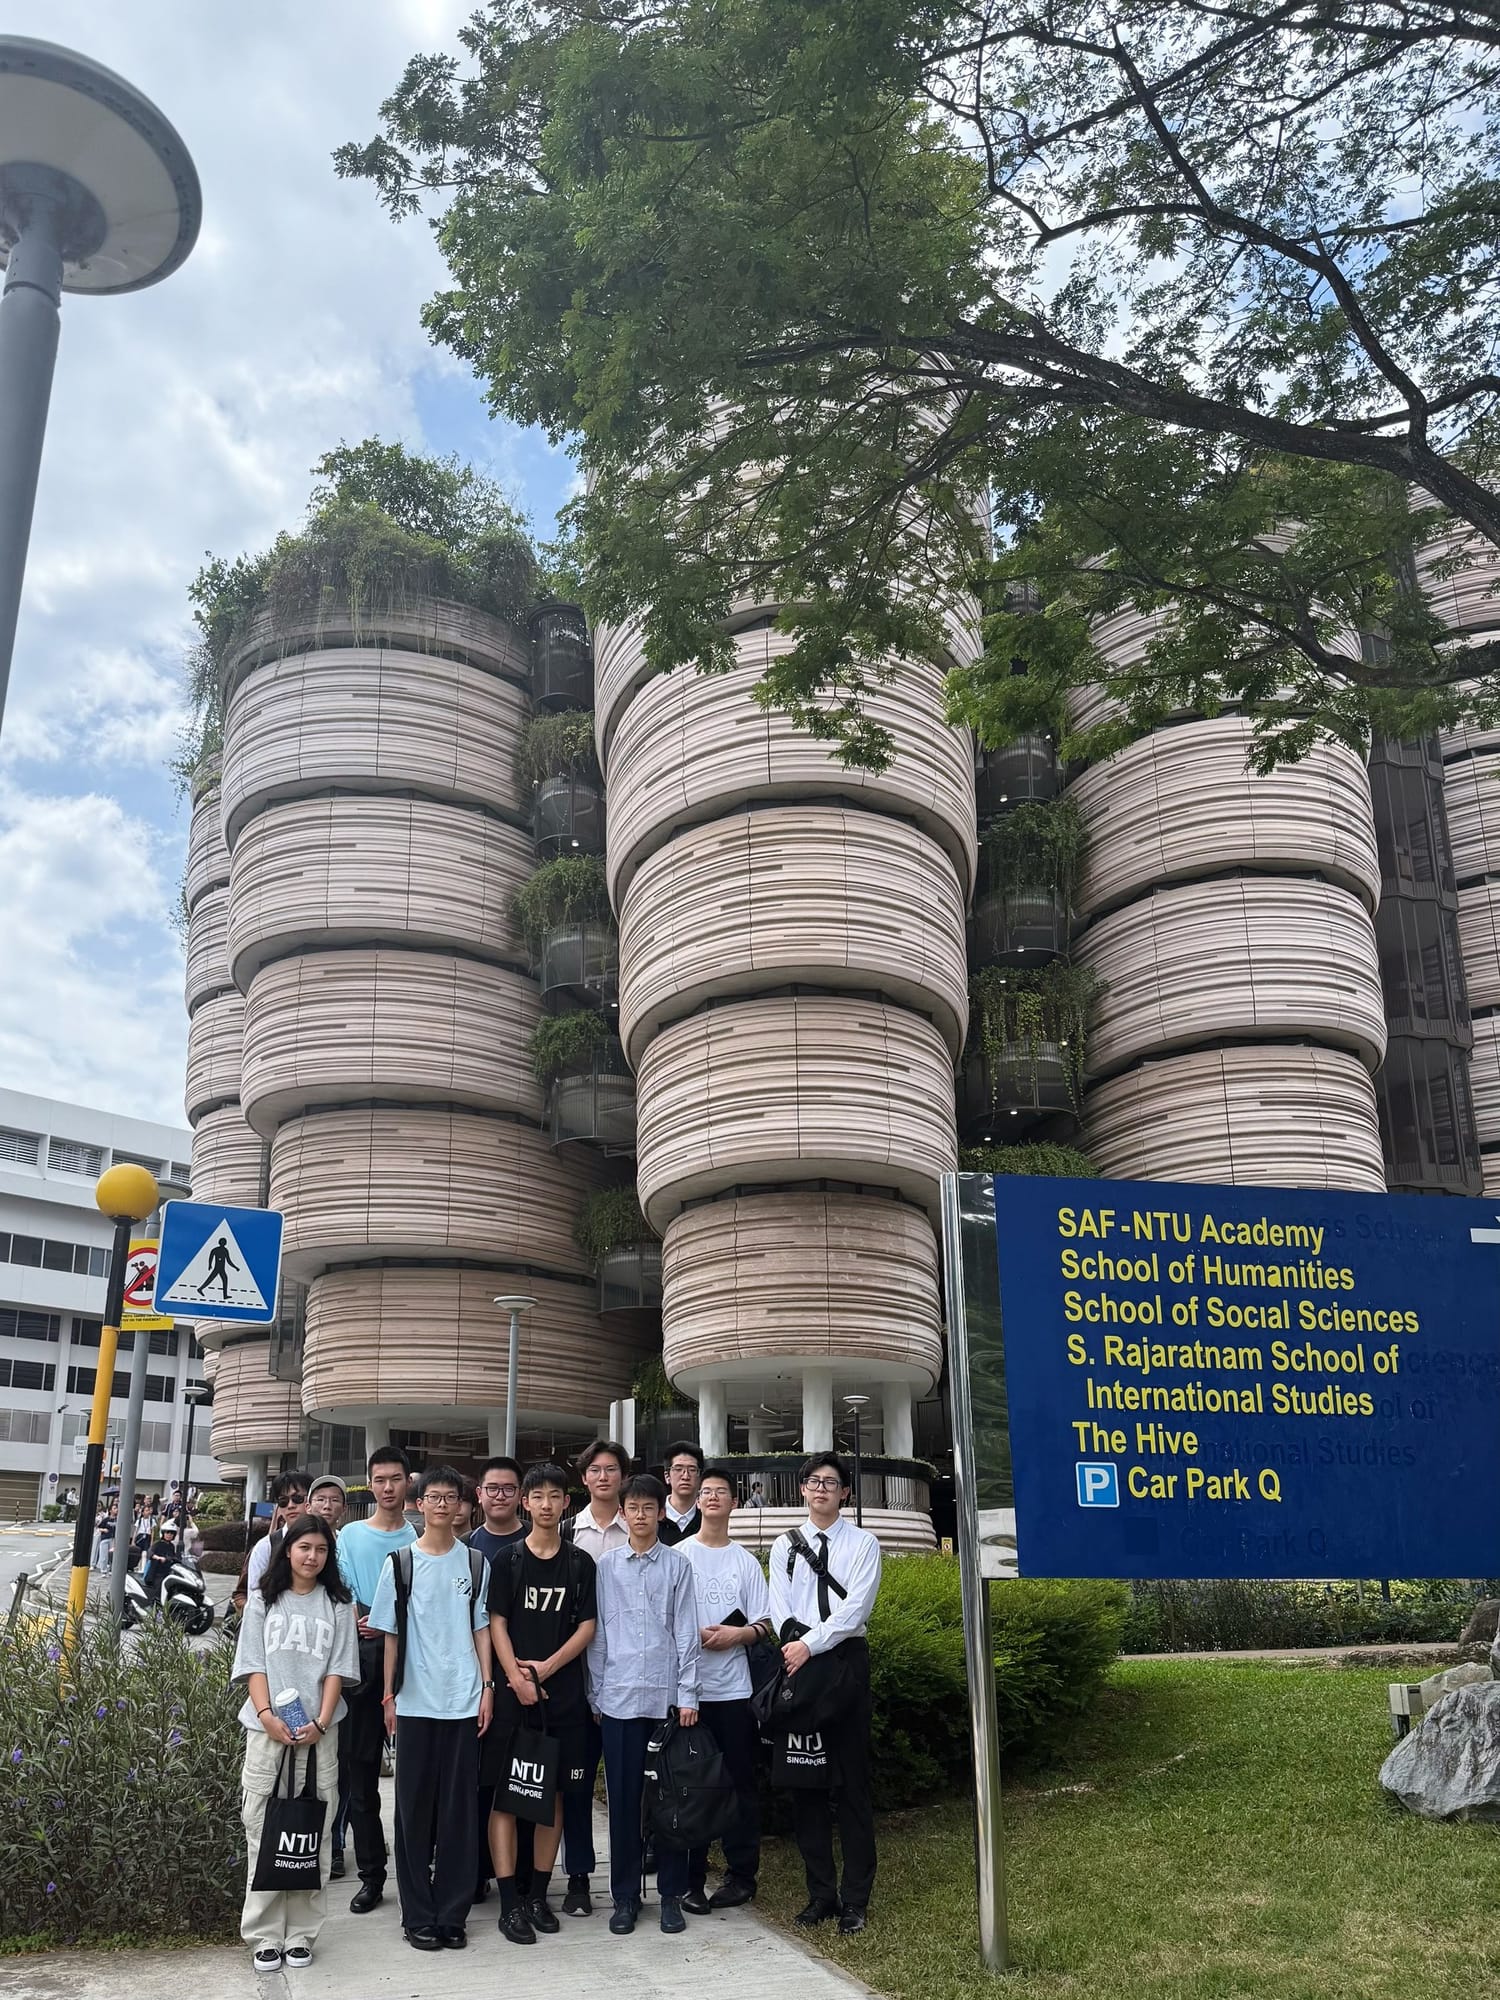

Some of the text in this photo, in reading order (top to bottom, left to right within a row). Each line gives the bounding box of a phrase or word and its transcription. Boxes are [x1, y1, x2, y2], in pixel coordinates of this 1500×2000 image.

[1058, 1207, 1191, 1243] SAF-NTU
[1199, 1214, 1324, 1256] Academy
[1061, 1248, 1355, 1290] School of Humanities
[1064, 1290, 1419, 1333] School of Social Sciences
[1067, 1333, 1399, 1375] S. Rajaratnam School of
[1087, 1378, 1264, 1413] International
[1271, 1383, 1374, 1416] Studies
[1071, 1421, 1198, 1455] The Hive
[1085, 1466, 1282, 1502] P Car Park Q
[524, 1584, 566, 1612] 1977
[263, 1613, 335, 1660] GAP
[510, 1757, 545, 1783] NTU
[278, 1831, 319, 1854] NTU
[274, 1859, 318, 1870] SINGAPORE
